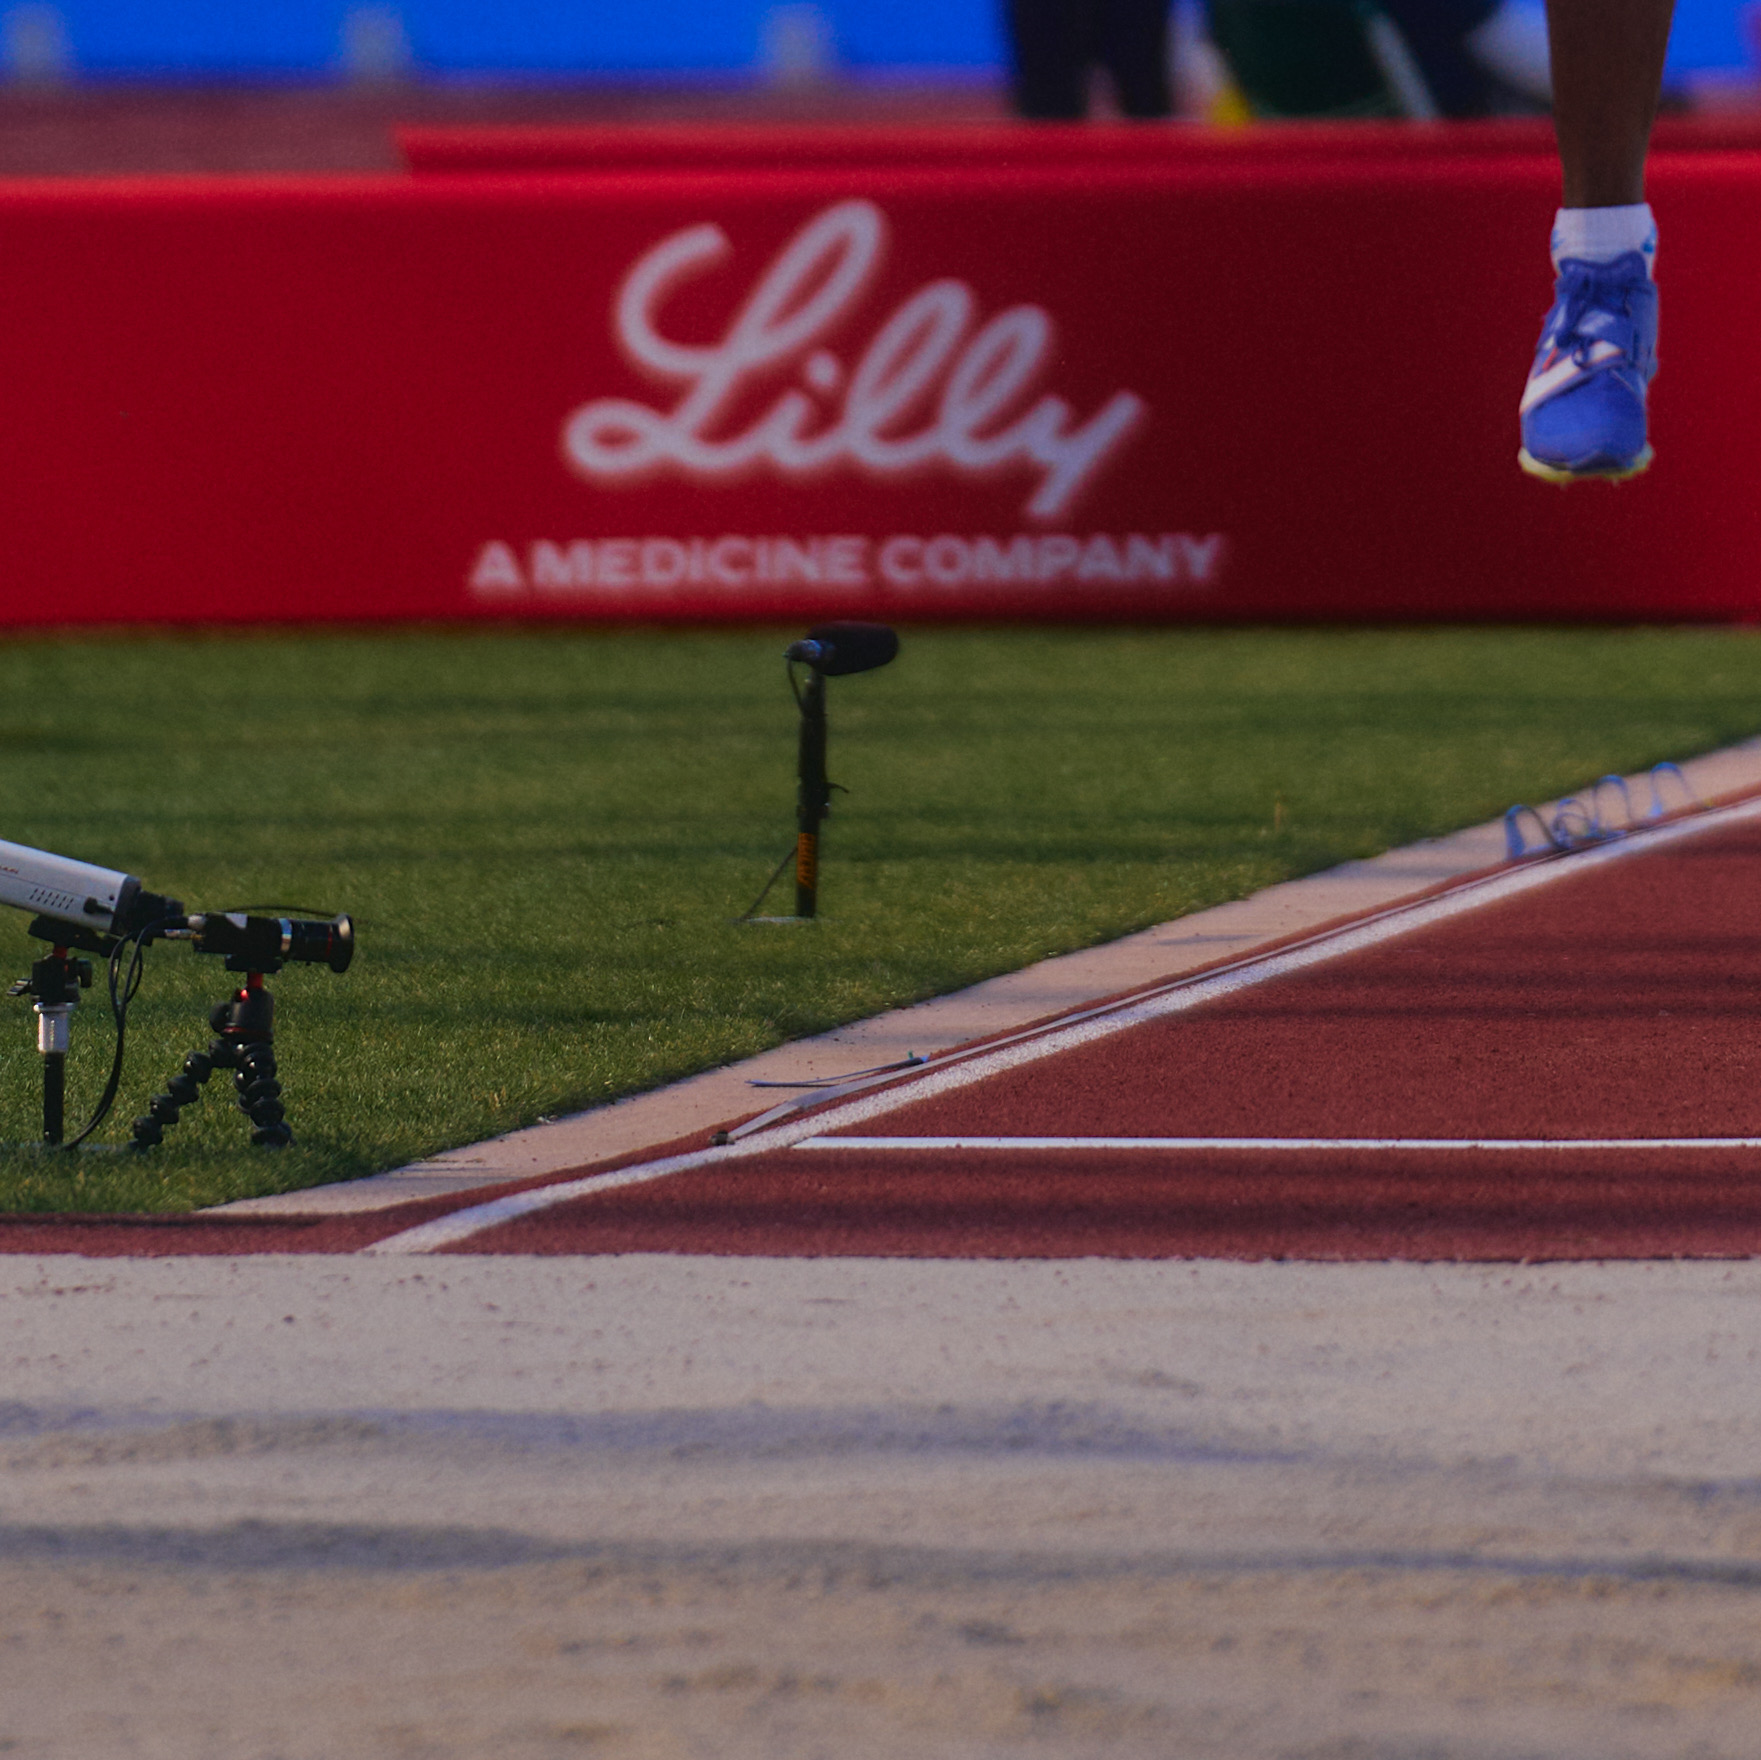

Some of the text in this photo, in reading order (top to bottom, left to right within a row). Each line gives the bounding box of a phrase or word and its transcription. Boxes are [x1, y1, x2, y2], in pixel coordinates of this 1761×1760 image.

[563, 198, 1143, 518] Lilly
[470, 534, 1222, 590] A MEDICINE COMPANY
